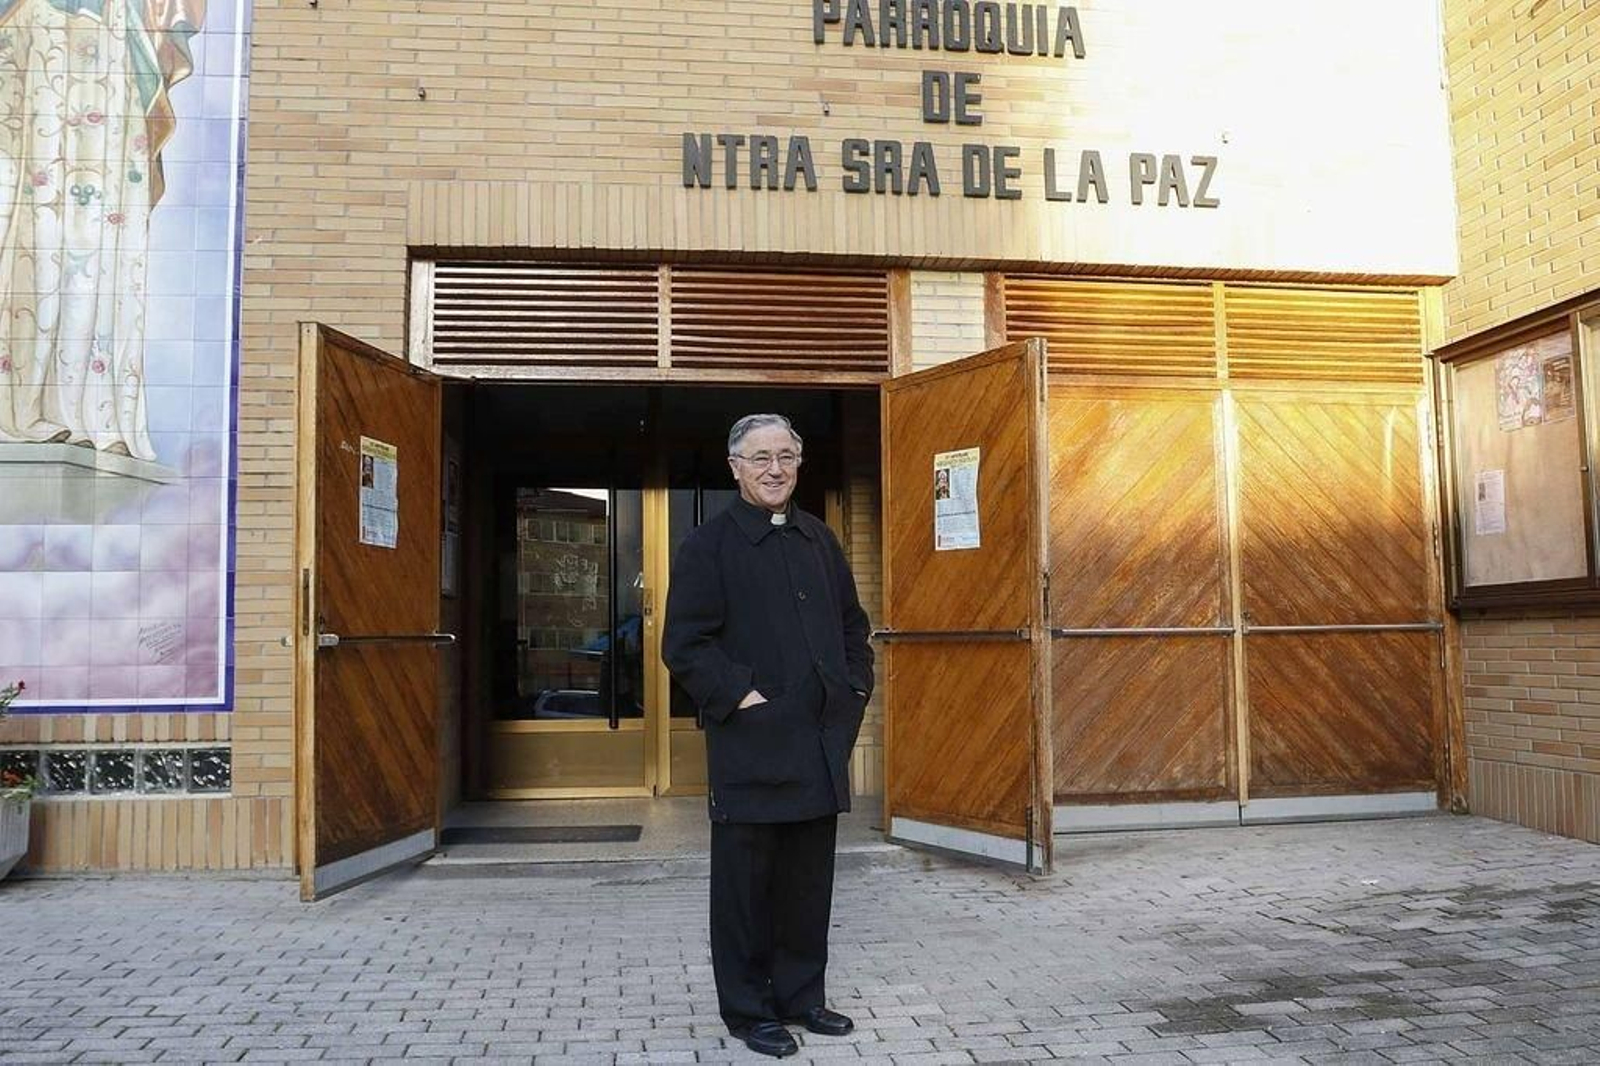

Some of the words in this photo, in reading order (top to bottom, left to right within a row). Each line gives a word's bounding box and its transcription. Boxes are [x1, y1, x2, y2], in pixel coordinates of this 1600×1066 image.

[813, 0, 1085, 58] PARROQUIA
[922, 69, 982, 126] DE
[682, 132, 817, 192] NTRA
[842, 138, 940, 197] SRA
[962, 143, 1022, 200] DE
[1043, 147, 1109, 204] LA
[1129, 152, 1220, 208] PAZ
